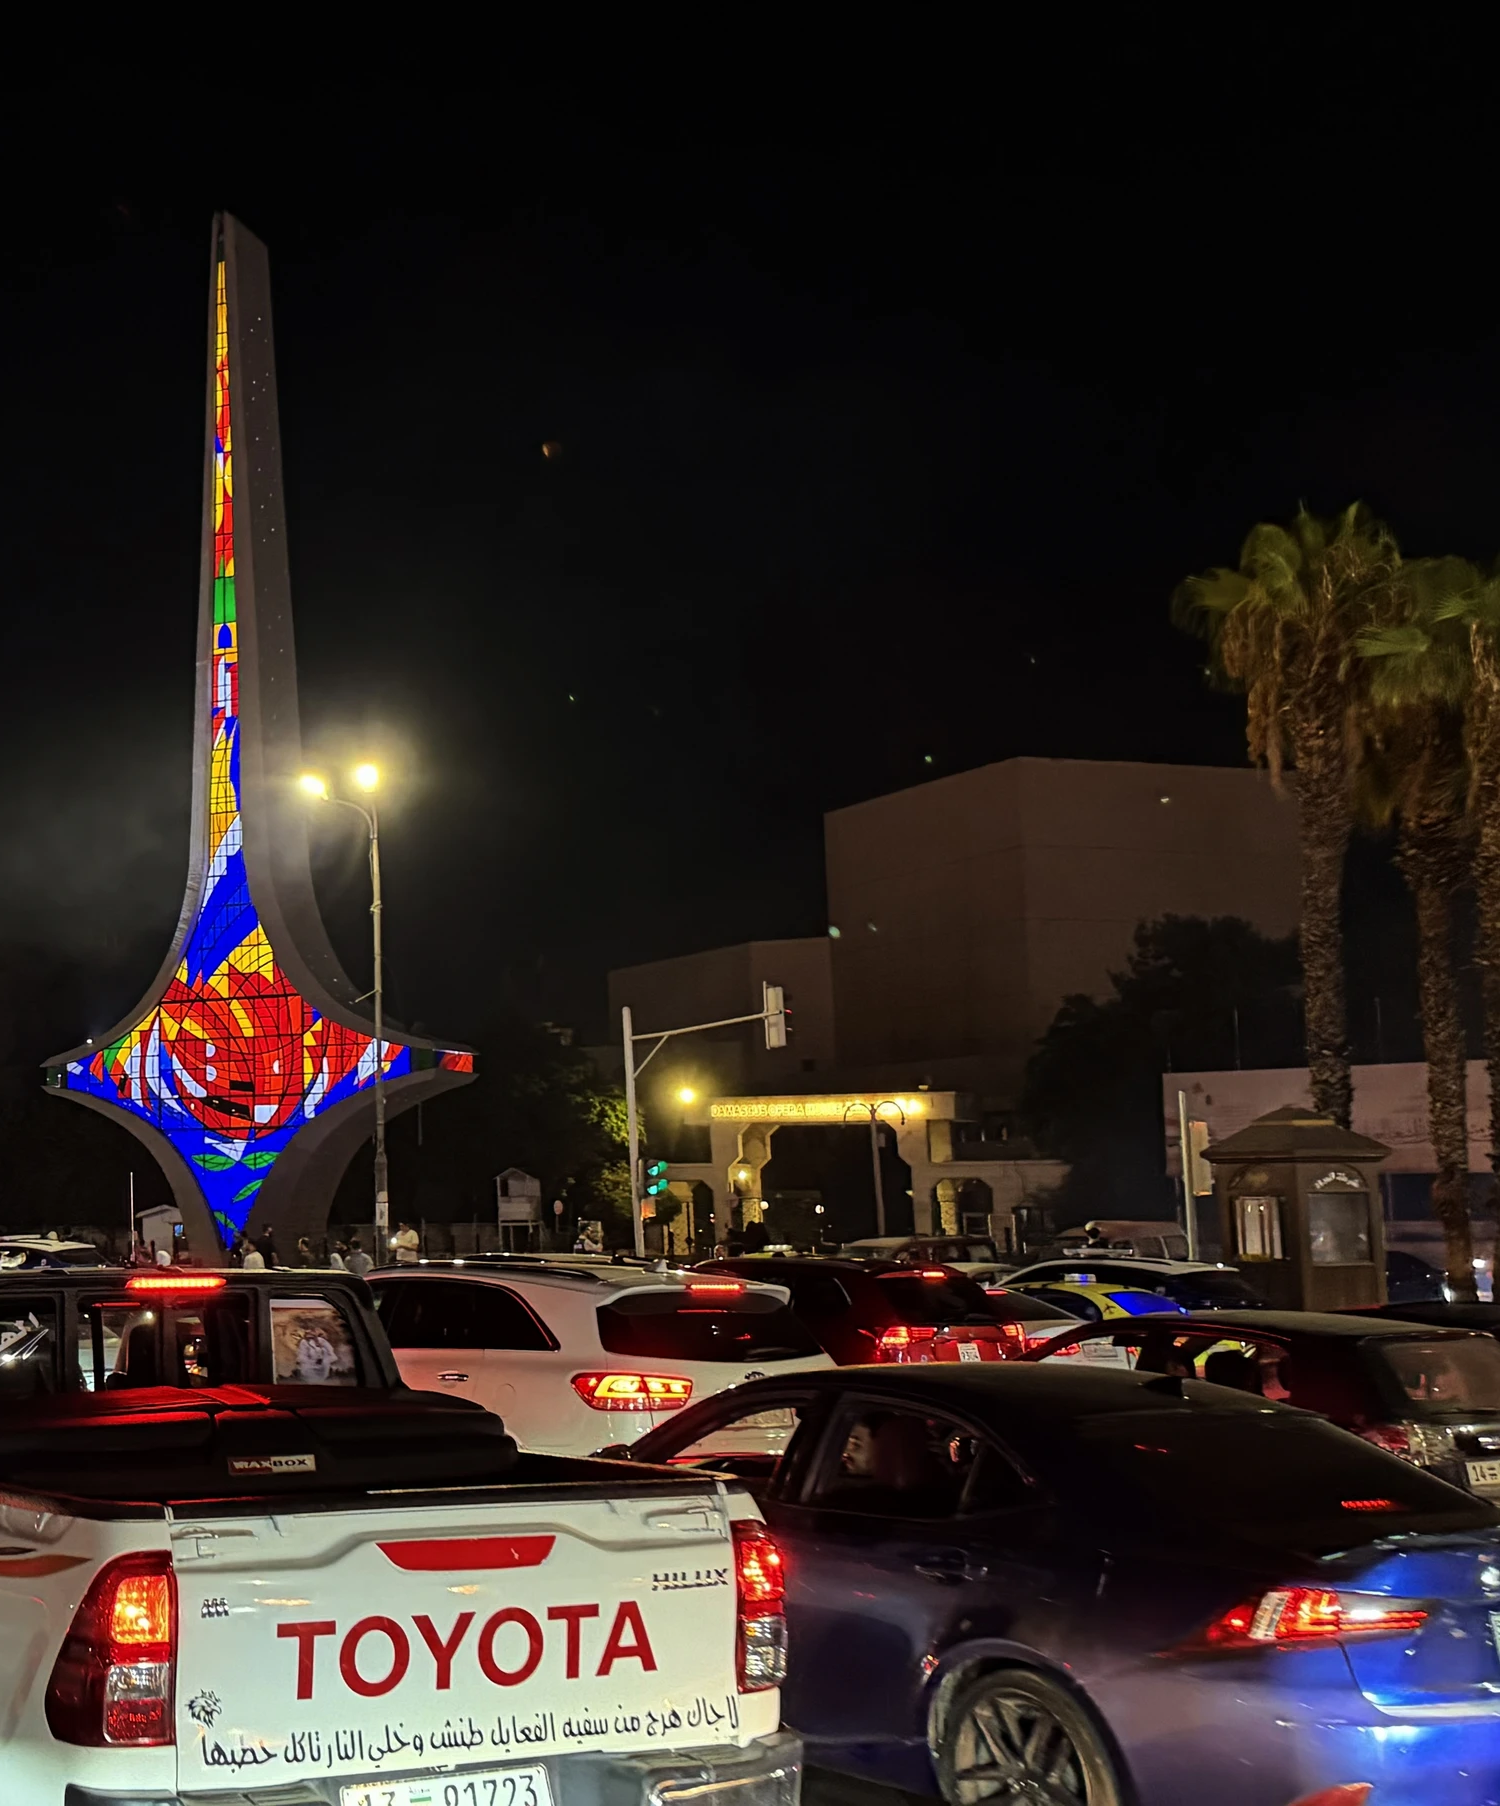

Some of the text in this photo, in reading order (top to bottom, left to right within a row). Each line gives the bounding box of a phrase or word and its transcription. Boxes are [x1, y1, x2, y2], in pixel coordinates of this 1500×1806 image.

[710, 1104, 767, 1118] DAMASCUS
[768, 1103, 805, 1117] OPERA
[651, 1568, 729, 1592] HILUX
[277, 1601, 658, 1700] TOYOTA
[430, 1717, 484, 1751] طنش
[491, 1711, 557, 1753] الفعايل
[563, 1707, 609, 1744] سفيه
[614, 1704, 641, 1734] من
[646, 1709, 682, 1737] هرج
[202, 1733, 278, 1773] حطبها
[327, 1730, 364, 1768] النار
